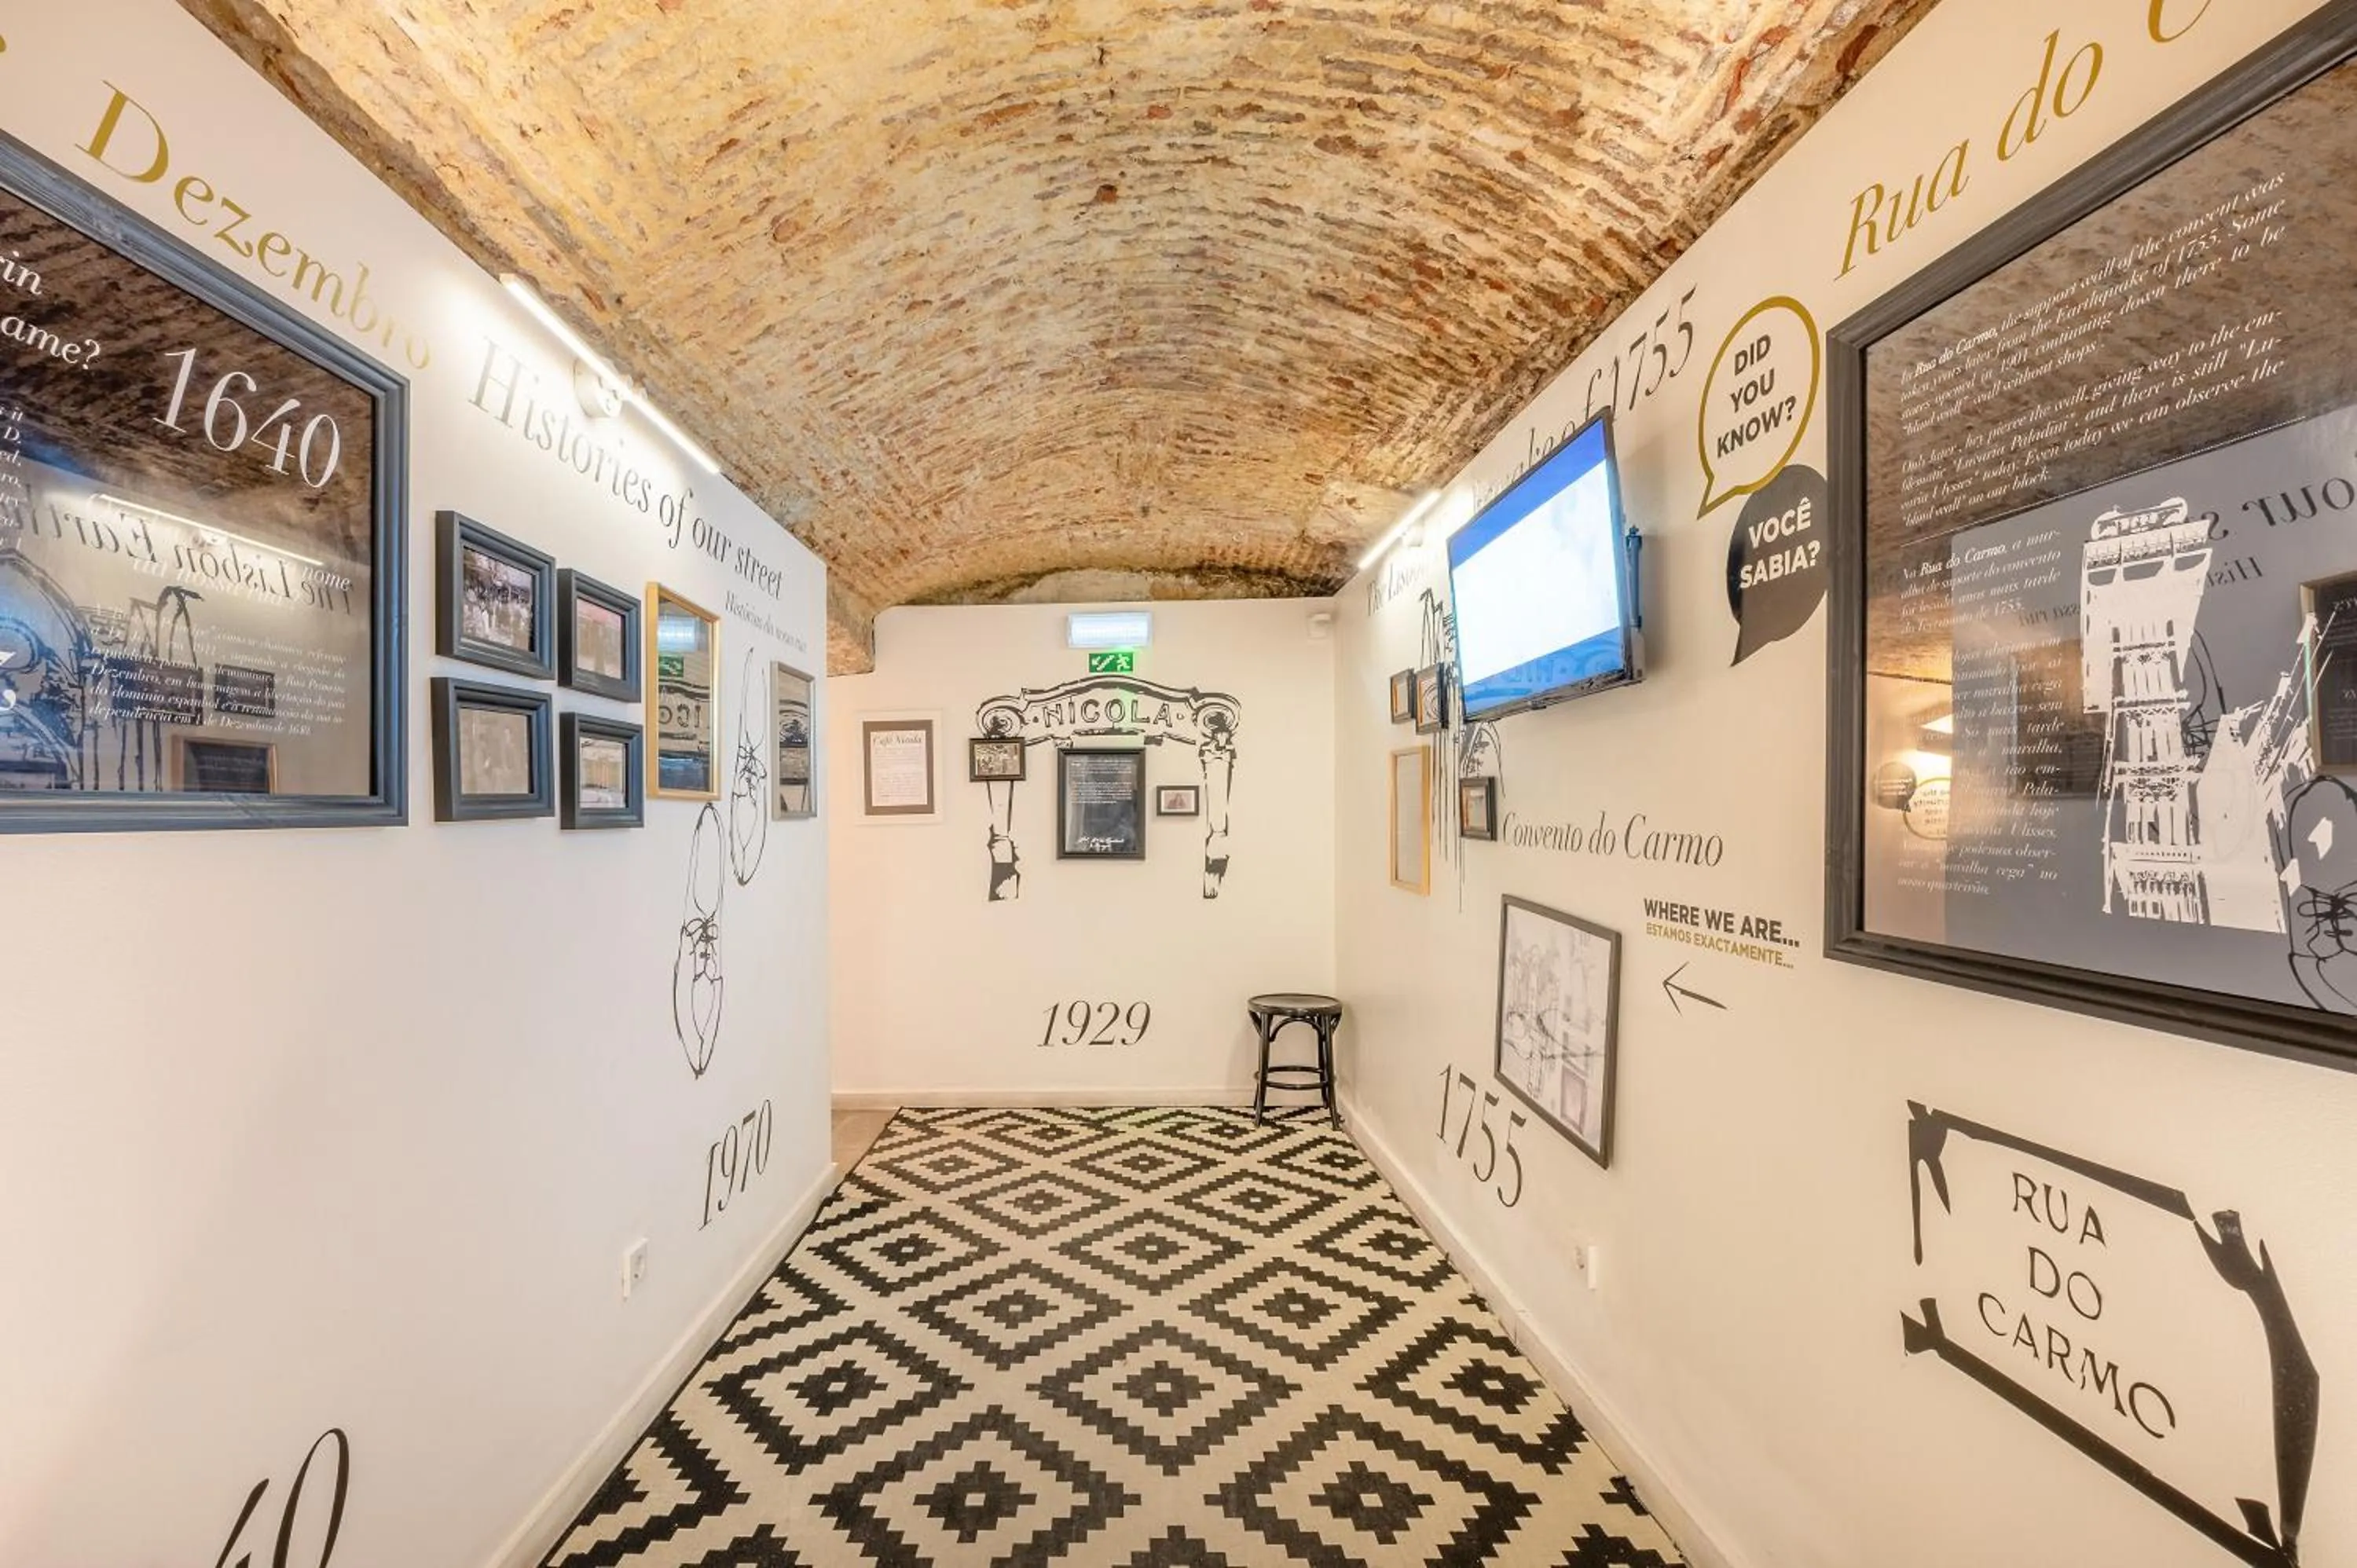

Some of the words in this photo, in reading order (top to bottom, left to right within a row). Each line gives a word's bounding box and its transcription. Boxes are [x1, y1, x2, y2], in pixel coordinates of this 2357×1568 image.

[1834, 137, 1970, 282] Rua
[1996, 27, 2104, 162] do
[75, 79, 431, 370] Dezembro
[2168, 195, 2239, 243] convent
[2245, 172, 2286, 202] was
[2120, 284, 2166, 315] down
[2174, 257, 2222, 289] there
[1609, 284, 1697, 425] 1755
[1733, 334, 1772, 376] DID
[2175, 375, 2245, 410] observe
[2250, 358, 2286, 383] the
[152, 347, 342, 488] 1640
[1730, 368, 1776, 414] YOU
[1716, 395, 1797, 459] KNOW?
[468, 335, 651, 513] Histories
[658, 488, 694, 550] of
[691, 515, 732, 563] our
[735, 546, 785, 601] street
[1747, 496, 1812, 548] VOCÊ
[1739, 540, 1820, 589] SABIA?
[1919, 560, 1943, 577] Rua
[1945, 551, 1961, 569] do
[1043, 697, 1174, 728] NICOLA
[1502, 811, 1582, 854] Convento
[1588, 809, 1616, 857] do
[1624, 812, 1725, 868] Carmo
[1643, 898, 1701, 928] WHERE
[1703, 907, 1736, 935] WE
[1739, 914, 1802, 949] ARE...
[1645, 921, 1693, 947] ESTAMOS
[1693, 930, 1795, 969] EXACTAMENTE...
[1037, 999, 1151, 1048] 1929
[698, 1098, 772, 1231] 1970
[1435, 1063, 1528, 1208] 1755
[2011, 1171, 2107, 1248] RUA
[2027, 1245, 2103, 1321] DO
[1977, 1291, 2176, 1440] CARMO
